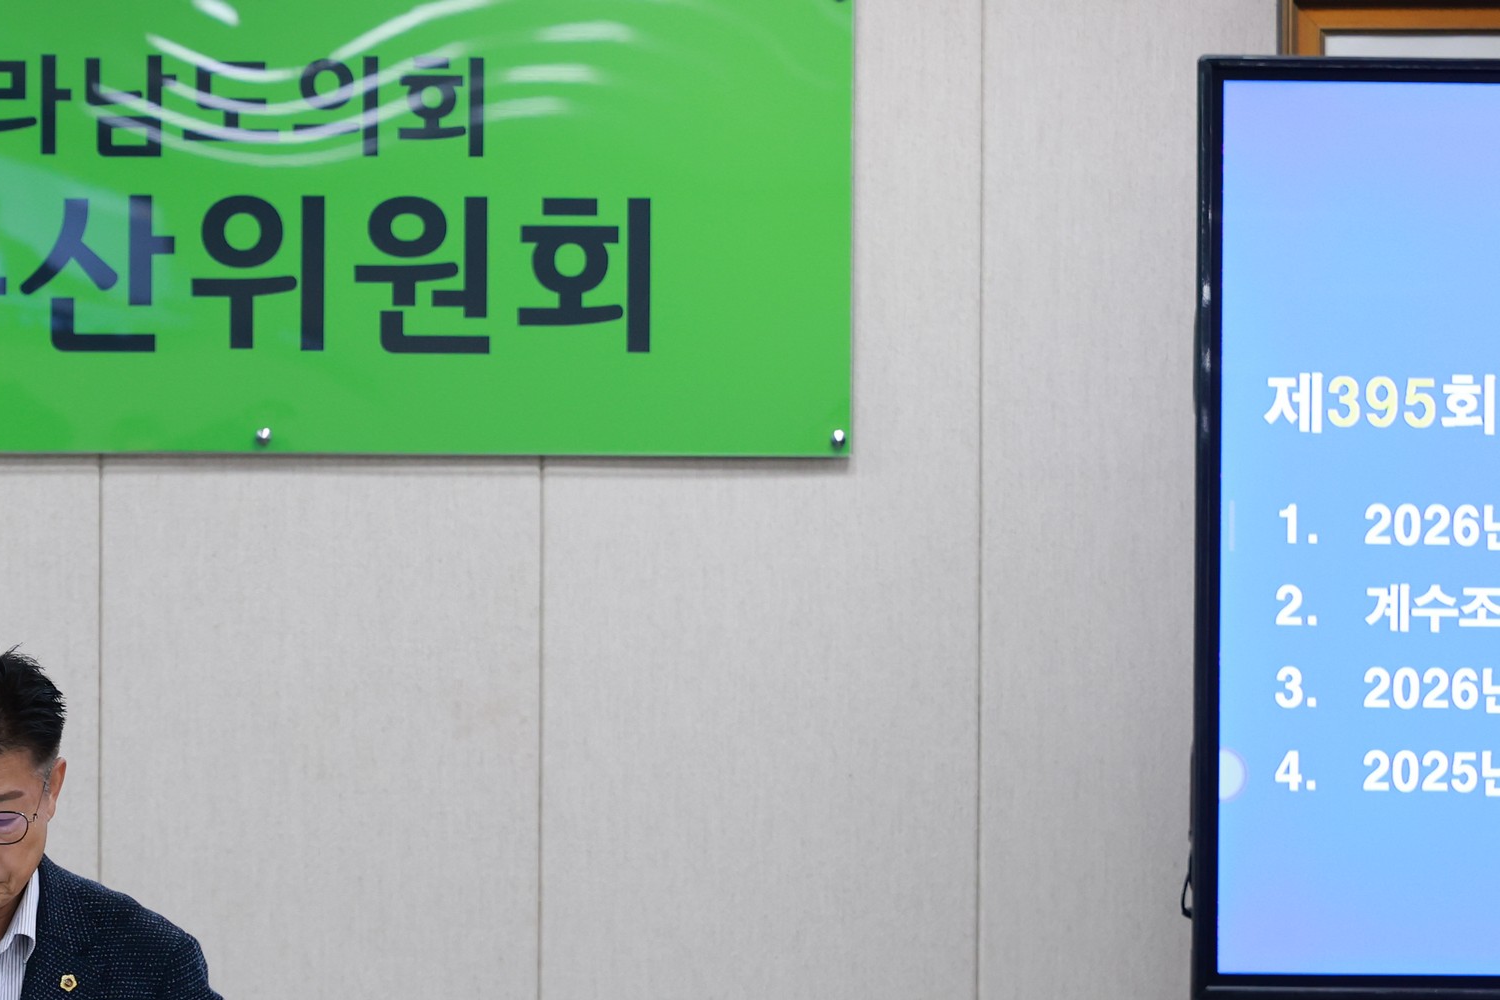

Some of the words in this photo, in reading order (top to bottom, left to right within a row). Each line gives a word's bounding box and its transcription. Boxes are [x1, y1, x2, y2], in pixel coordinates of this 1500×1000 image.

[1264, 372, 1497, 436] 제395회
[1279, 504, 1318, 545] 1.
[1275, 585, 1318, 626] 2.
[1366, 584, 1500, 633] 계수조
[1275, 667, 1318, 708] 3.
[1275, 751, 1317, 792] 4.
